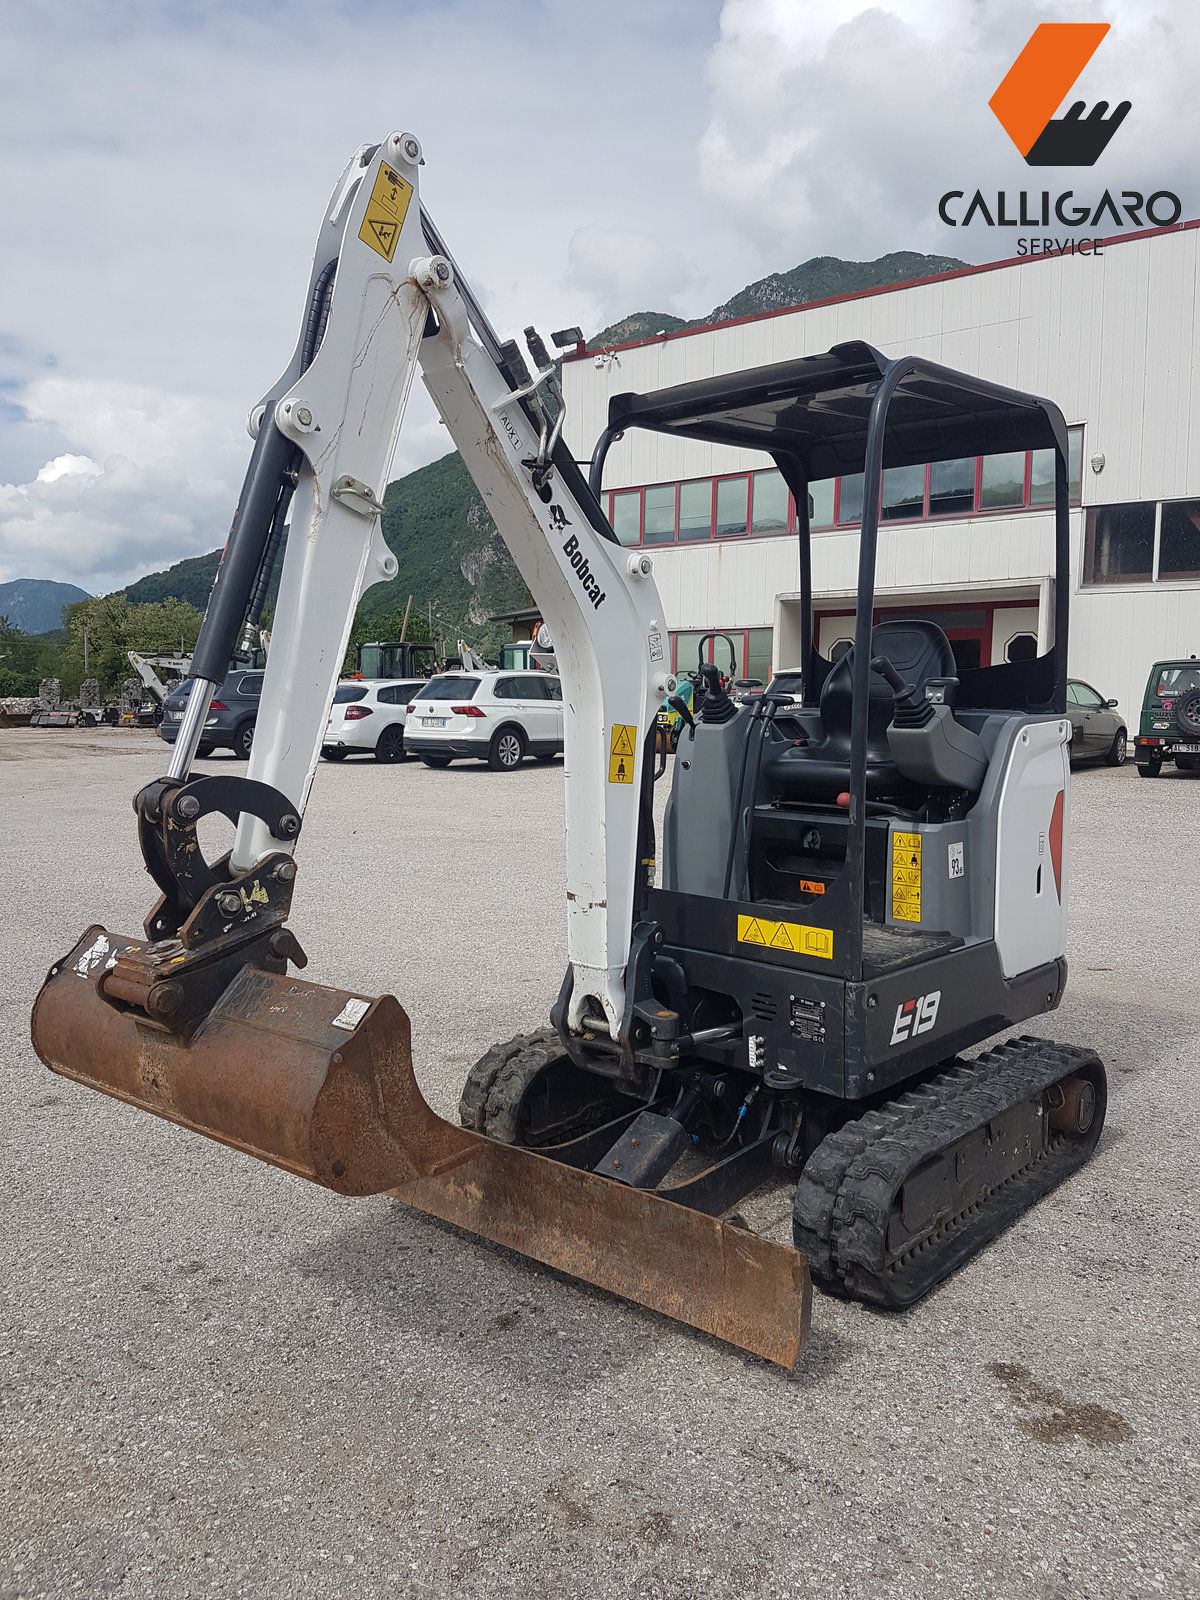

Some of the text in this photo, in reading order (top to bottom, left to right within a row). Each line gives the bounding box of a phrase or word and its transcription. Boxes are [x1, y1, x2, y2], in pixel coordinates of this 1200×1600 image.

[501, 416, 516, 439] AUX
[562, 533, 607, 611] Bobcat
[889, 990, 942, 1046] E19
